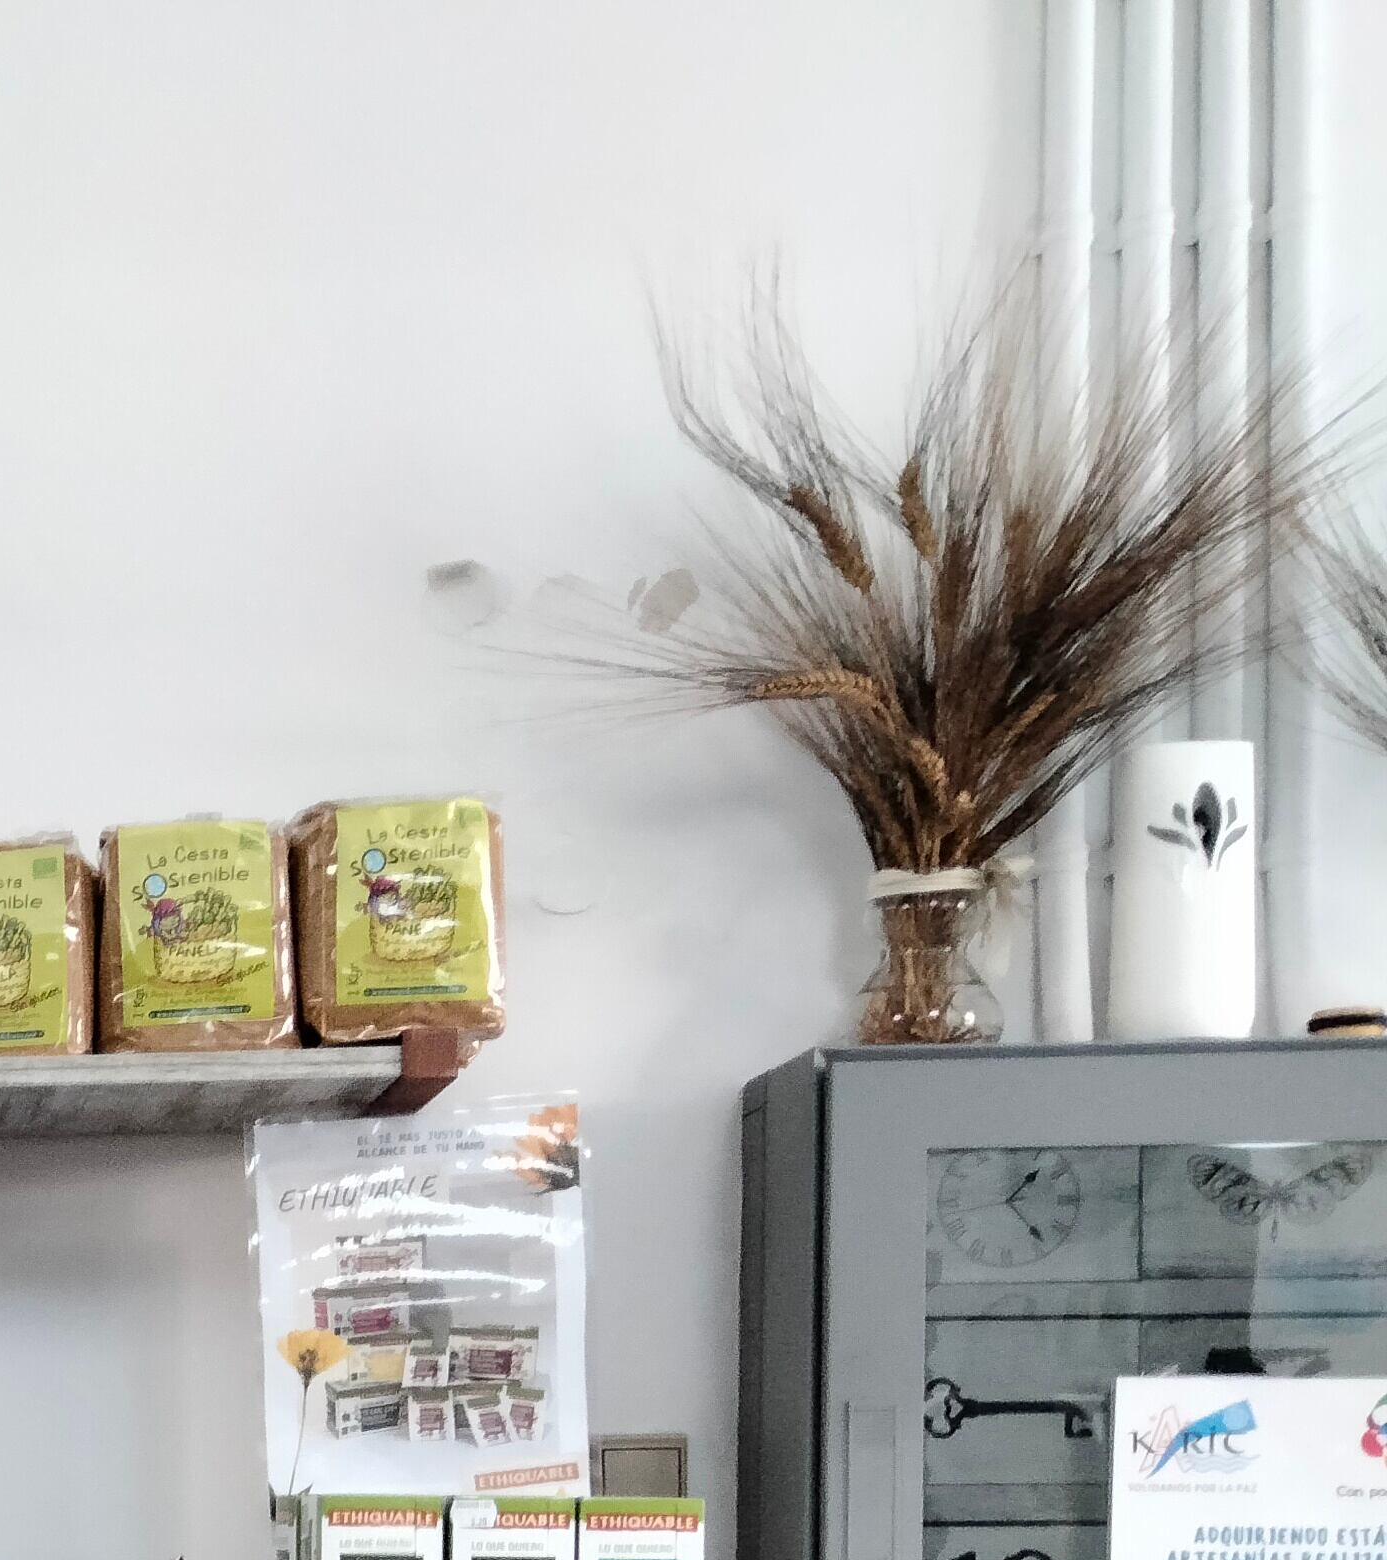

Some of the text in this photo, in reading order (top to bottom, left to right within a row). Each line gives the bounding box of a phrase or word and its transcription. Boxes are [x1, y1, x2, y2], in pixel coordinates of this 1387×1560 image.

[147, 846, 230, 870] La Cesta
[479, 1465, 577, 1489] ETHIQUABLE
[331, 1511, 435, 1527] ETHIQUABLE
[589, 1514, 695, 1530] ETHIQUABLE
[1194, 1527, 1328, 1546] ADQUIRIENDO
